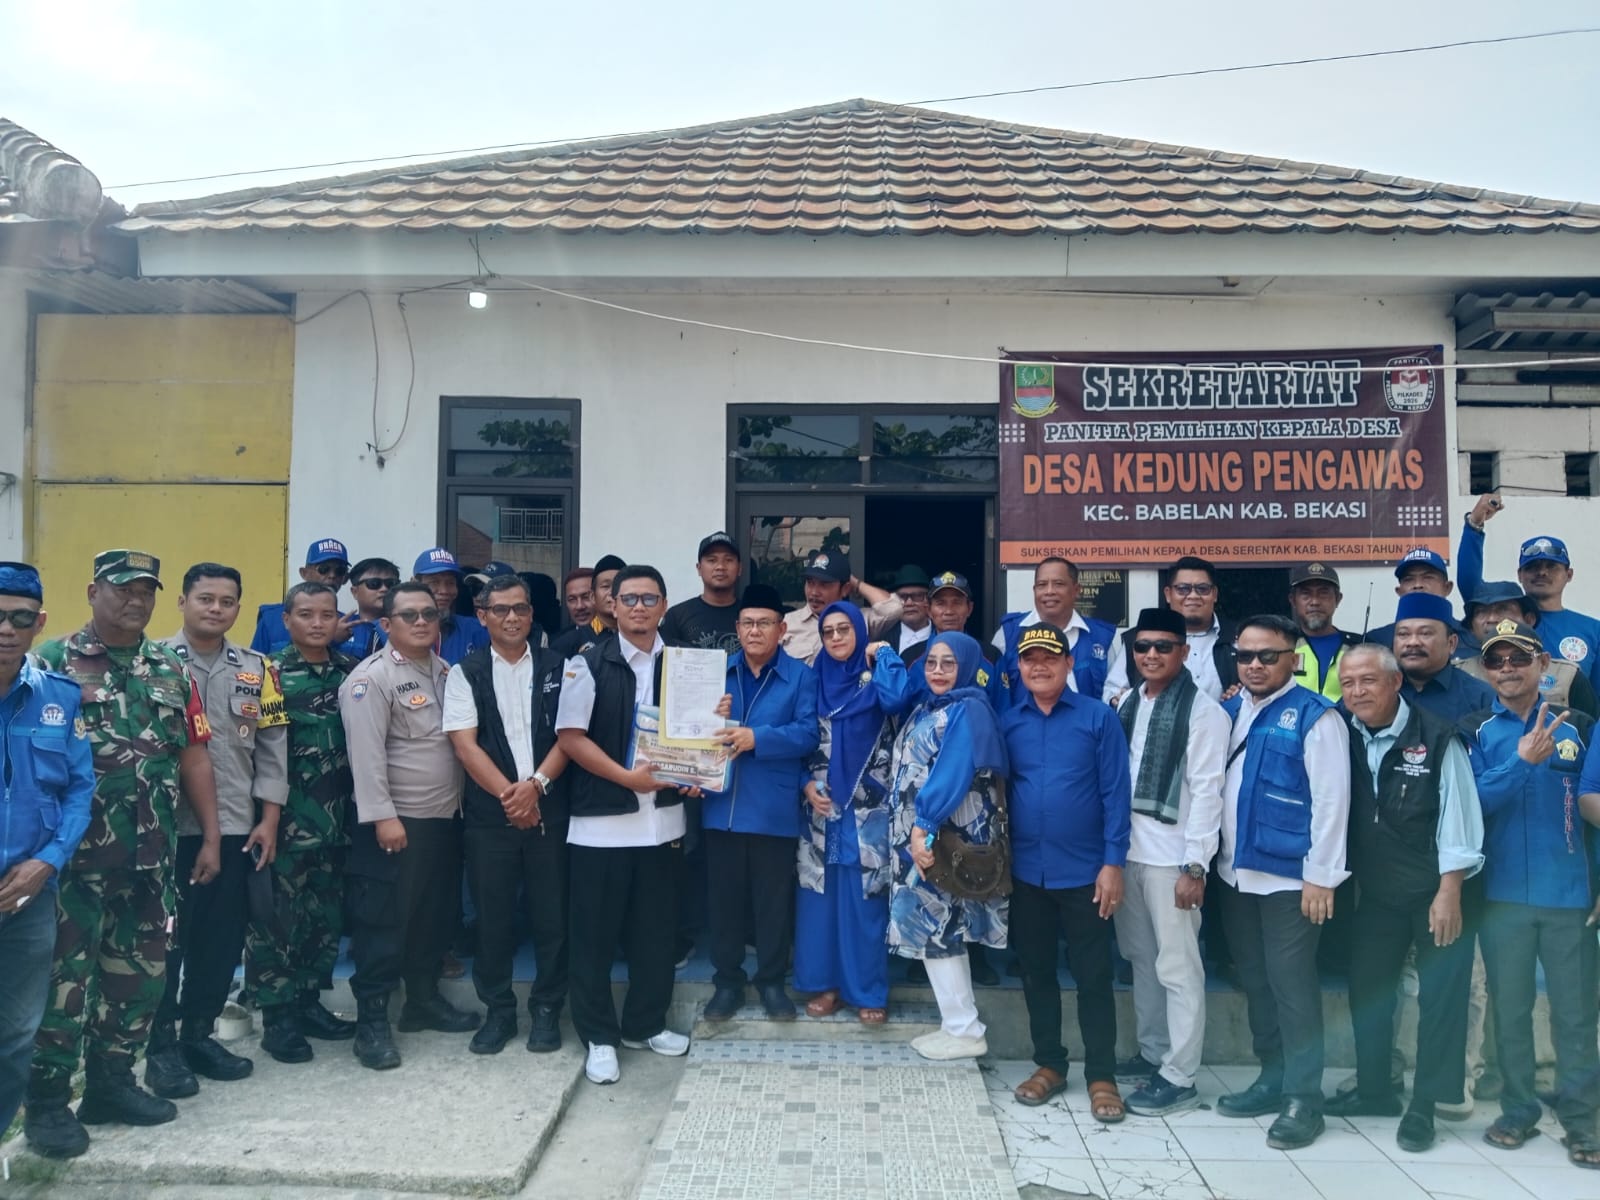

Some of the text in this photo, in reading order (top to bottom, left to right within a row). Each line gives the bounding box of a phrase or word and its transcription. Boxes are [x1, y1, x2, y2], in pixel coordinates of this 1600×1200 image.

[1083, 360, 1360, 411] SEKRETARIAT
[1044, 417, 1402, 443] PANITIA PEMILIHAN KEPALA DESA
[1023, 449, 1424, 495] DESA KEDUNG PENGAWAS
[1083, 502, 1367, 521] KEC. BABELAN KAB. BEKASI
[1020, 546, 1088, 557] SUKSESKAN
[1091, 546, 1150, 556] PEMILIHAN
[1153, 546, 1197, 556] KEPALA
[1199, 545, 1230, 556] DESA
[1232, 545, 1291, 555] SERENTAK
[1294, 544, 1320, 555] KAB.
[1324, 544, 1364, 554] BEKASI
[1367, 544, 1403, 553] TAHUN
[1023, 629, 1057, 641] BRASA
